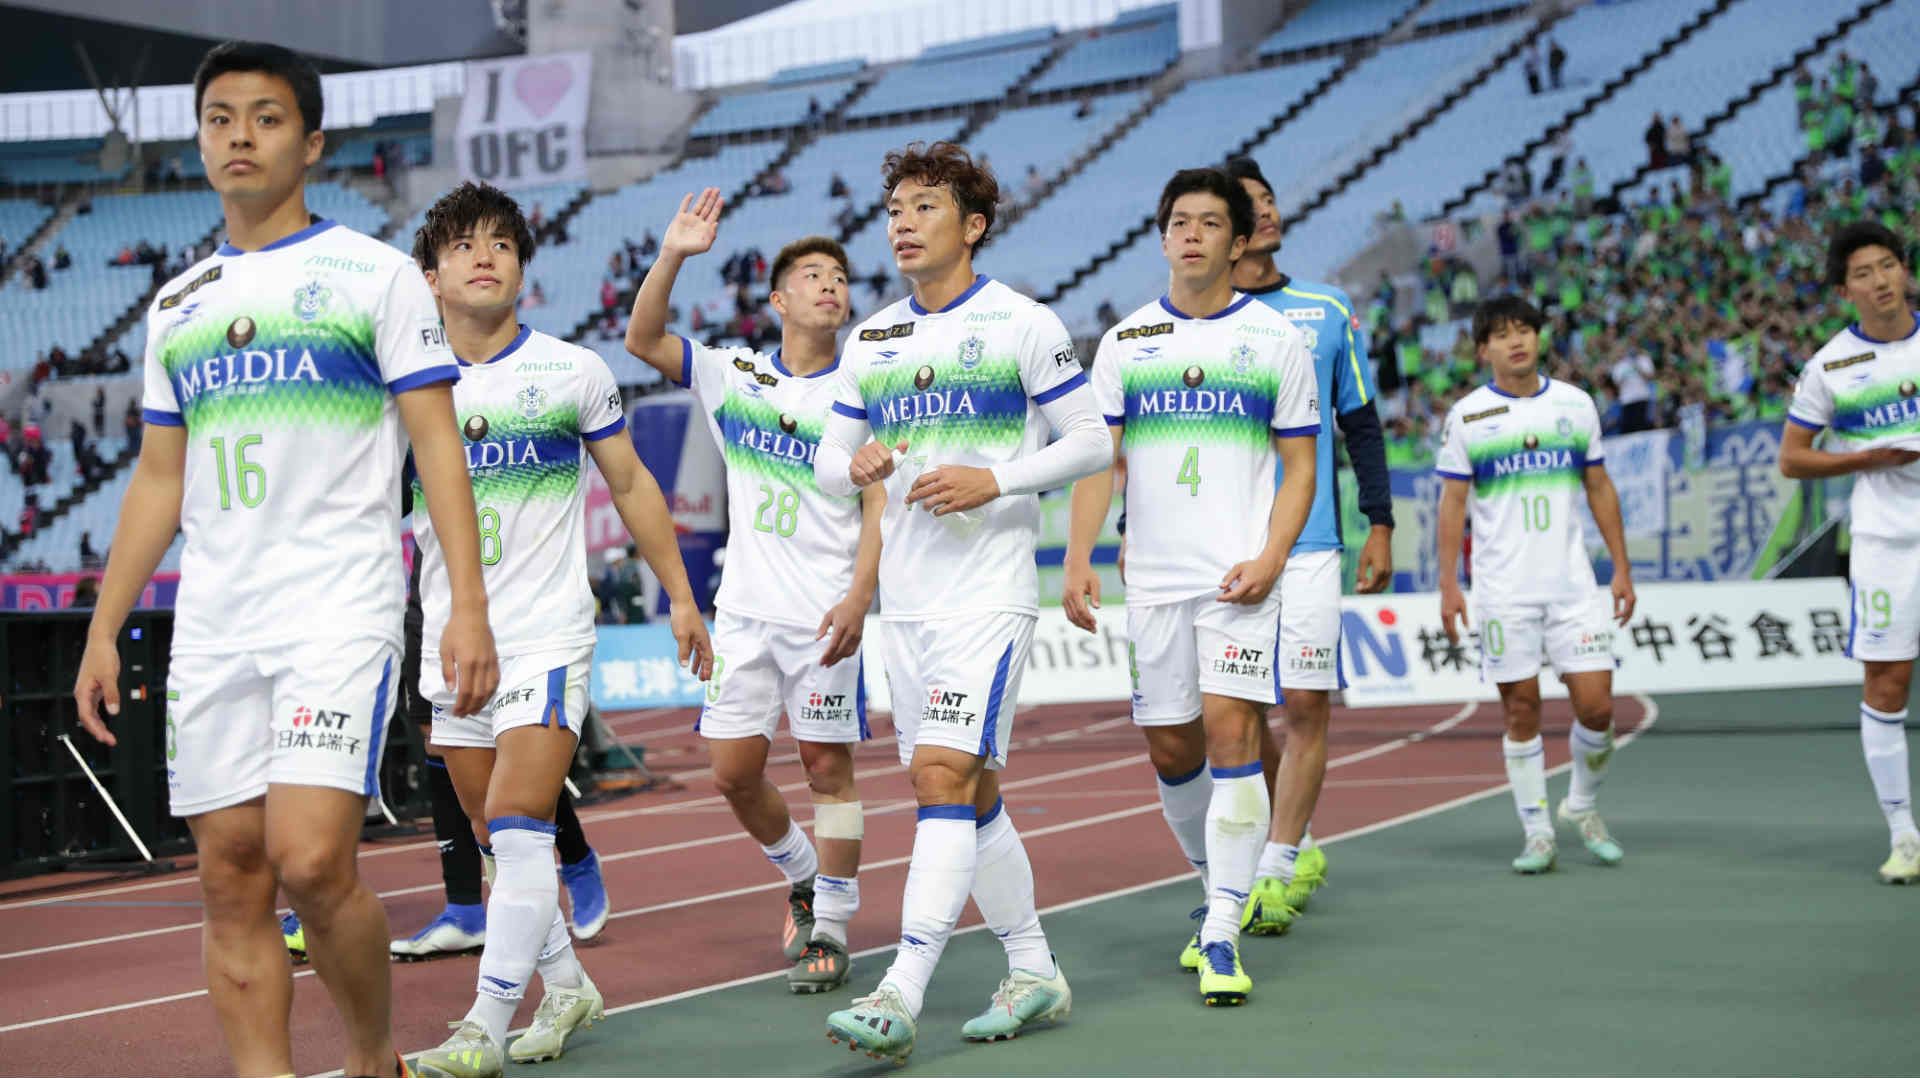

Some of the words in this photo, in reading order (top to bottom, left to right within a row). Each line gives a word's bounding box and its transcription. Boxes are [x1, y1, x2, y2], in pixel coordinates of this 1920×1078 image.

[179, 348, 323, 403] MELDIA
[880, 391, 976, 424] MELDIA
[1139, 390, 1246, 415] MELDIA
[210, 434, 266, 510] 16
[1176, 446, 1202, 496] 4
[1494, 450, 1573, 476] MELDIA
[753, 483, 799, 538] 28
[1521, 495, 1550, 532] 10
[1859, 589, 1891, 629] 19
[1631, 609, 1847, 663] 中谷食品
[1240, 648, 1262, 662] NT
[1214, 659, 1270, 679] 日本端子
[824, 695, 845, 707] NT
[941, 691, 968, 707] NT
[315, 709, 351, 730] NT
[801, 707, 852, 721] 日本端子
[278, 730, 362, 755] 日本端子
